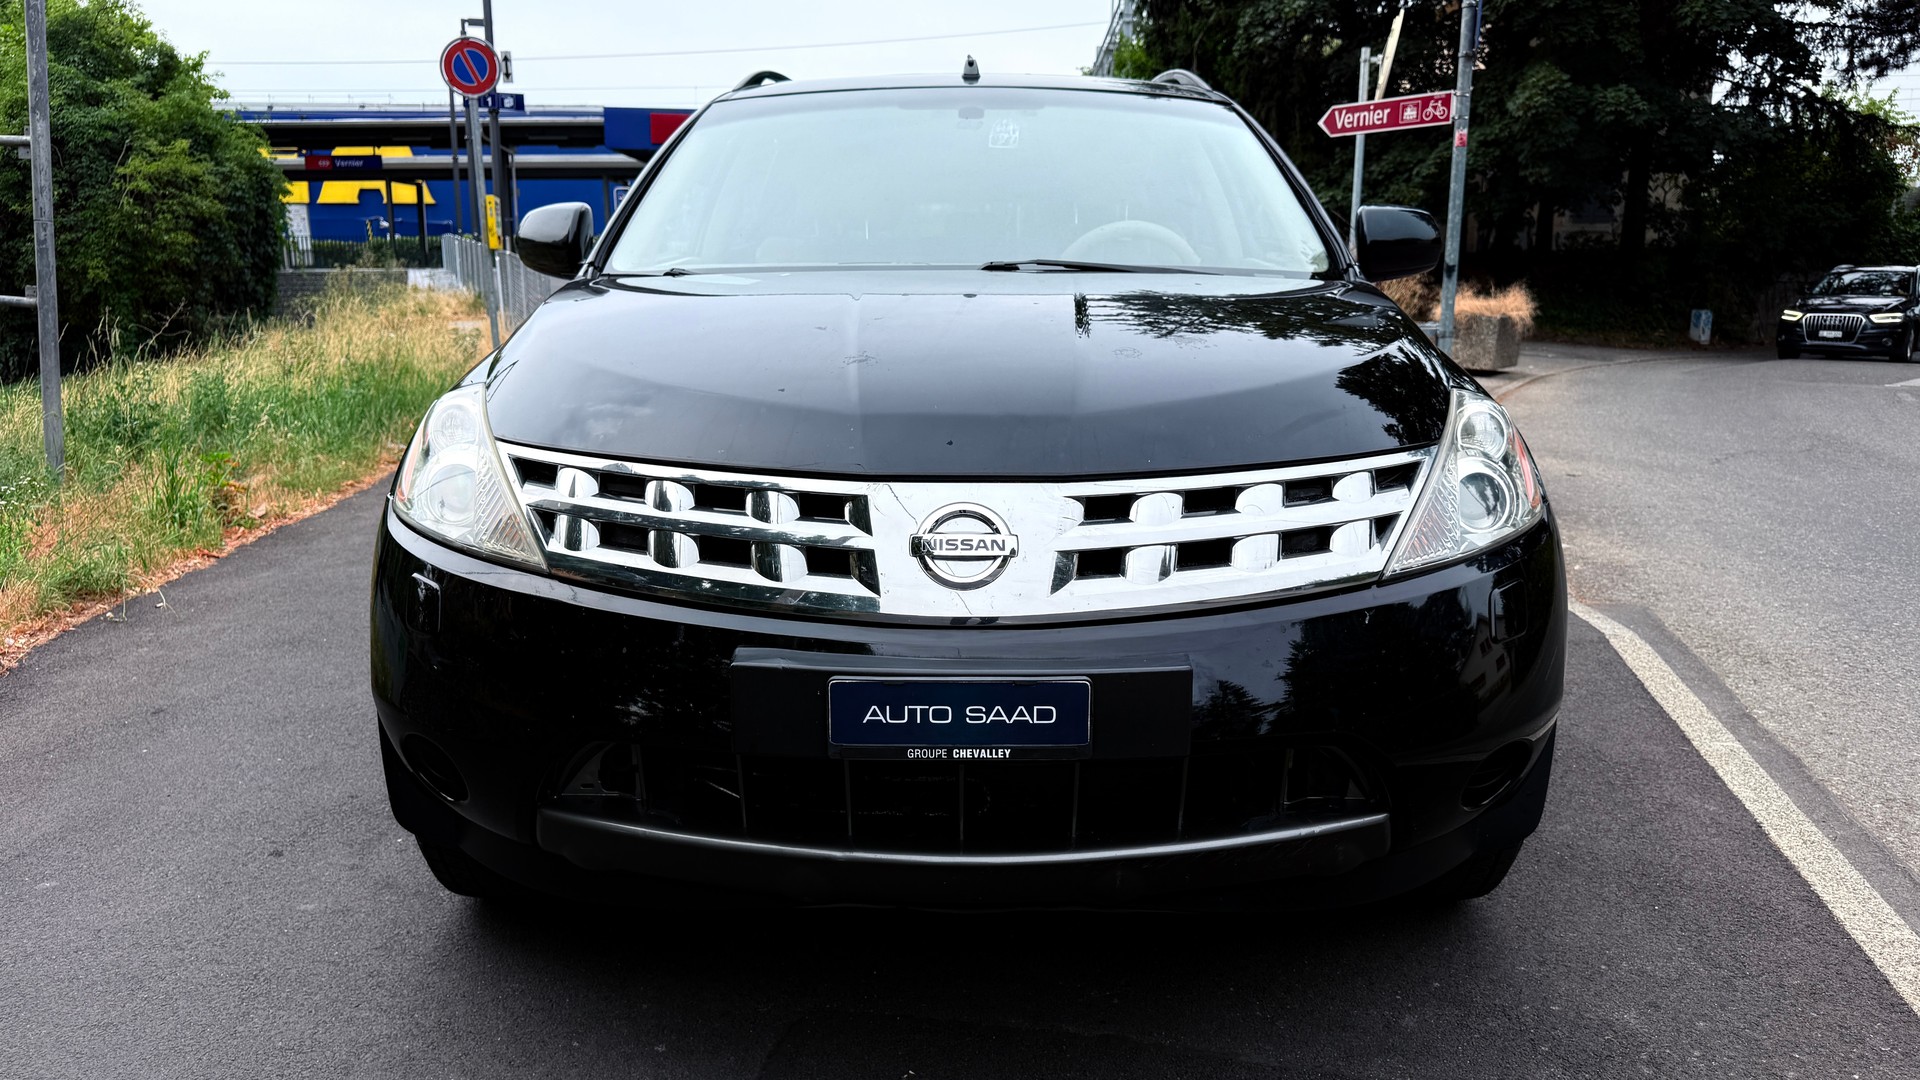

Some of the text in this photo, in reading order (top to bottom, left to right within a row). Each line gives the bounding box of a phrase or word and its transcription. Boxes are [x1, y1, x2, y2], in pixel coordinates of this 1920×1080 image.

[1334, 105, 1391, 130] Vernier
[334, 159, 364, 168] Vernier
[921, 538, 1006, 552] NISSAN
[862, 705, 1057, 724] AUTO SAAD
[907, 749, 1011, 759] GROUPE CHEVALLEY
